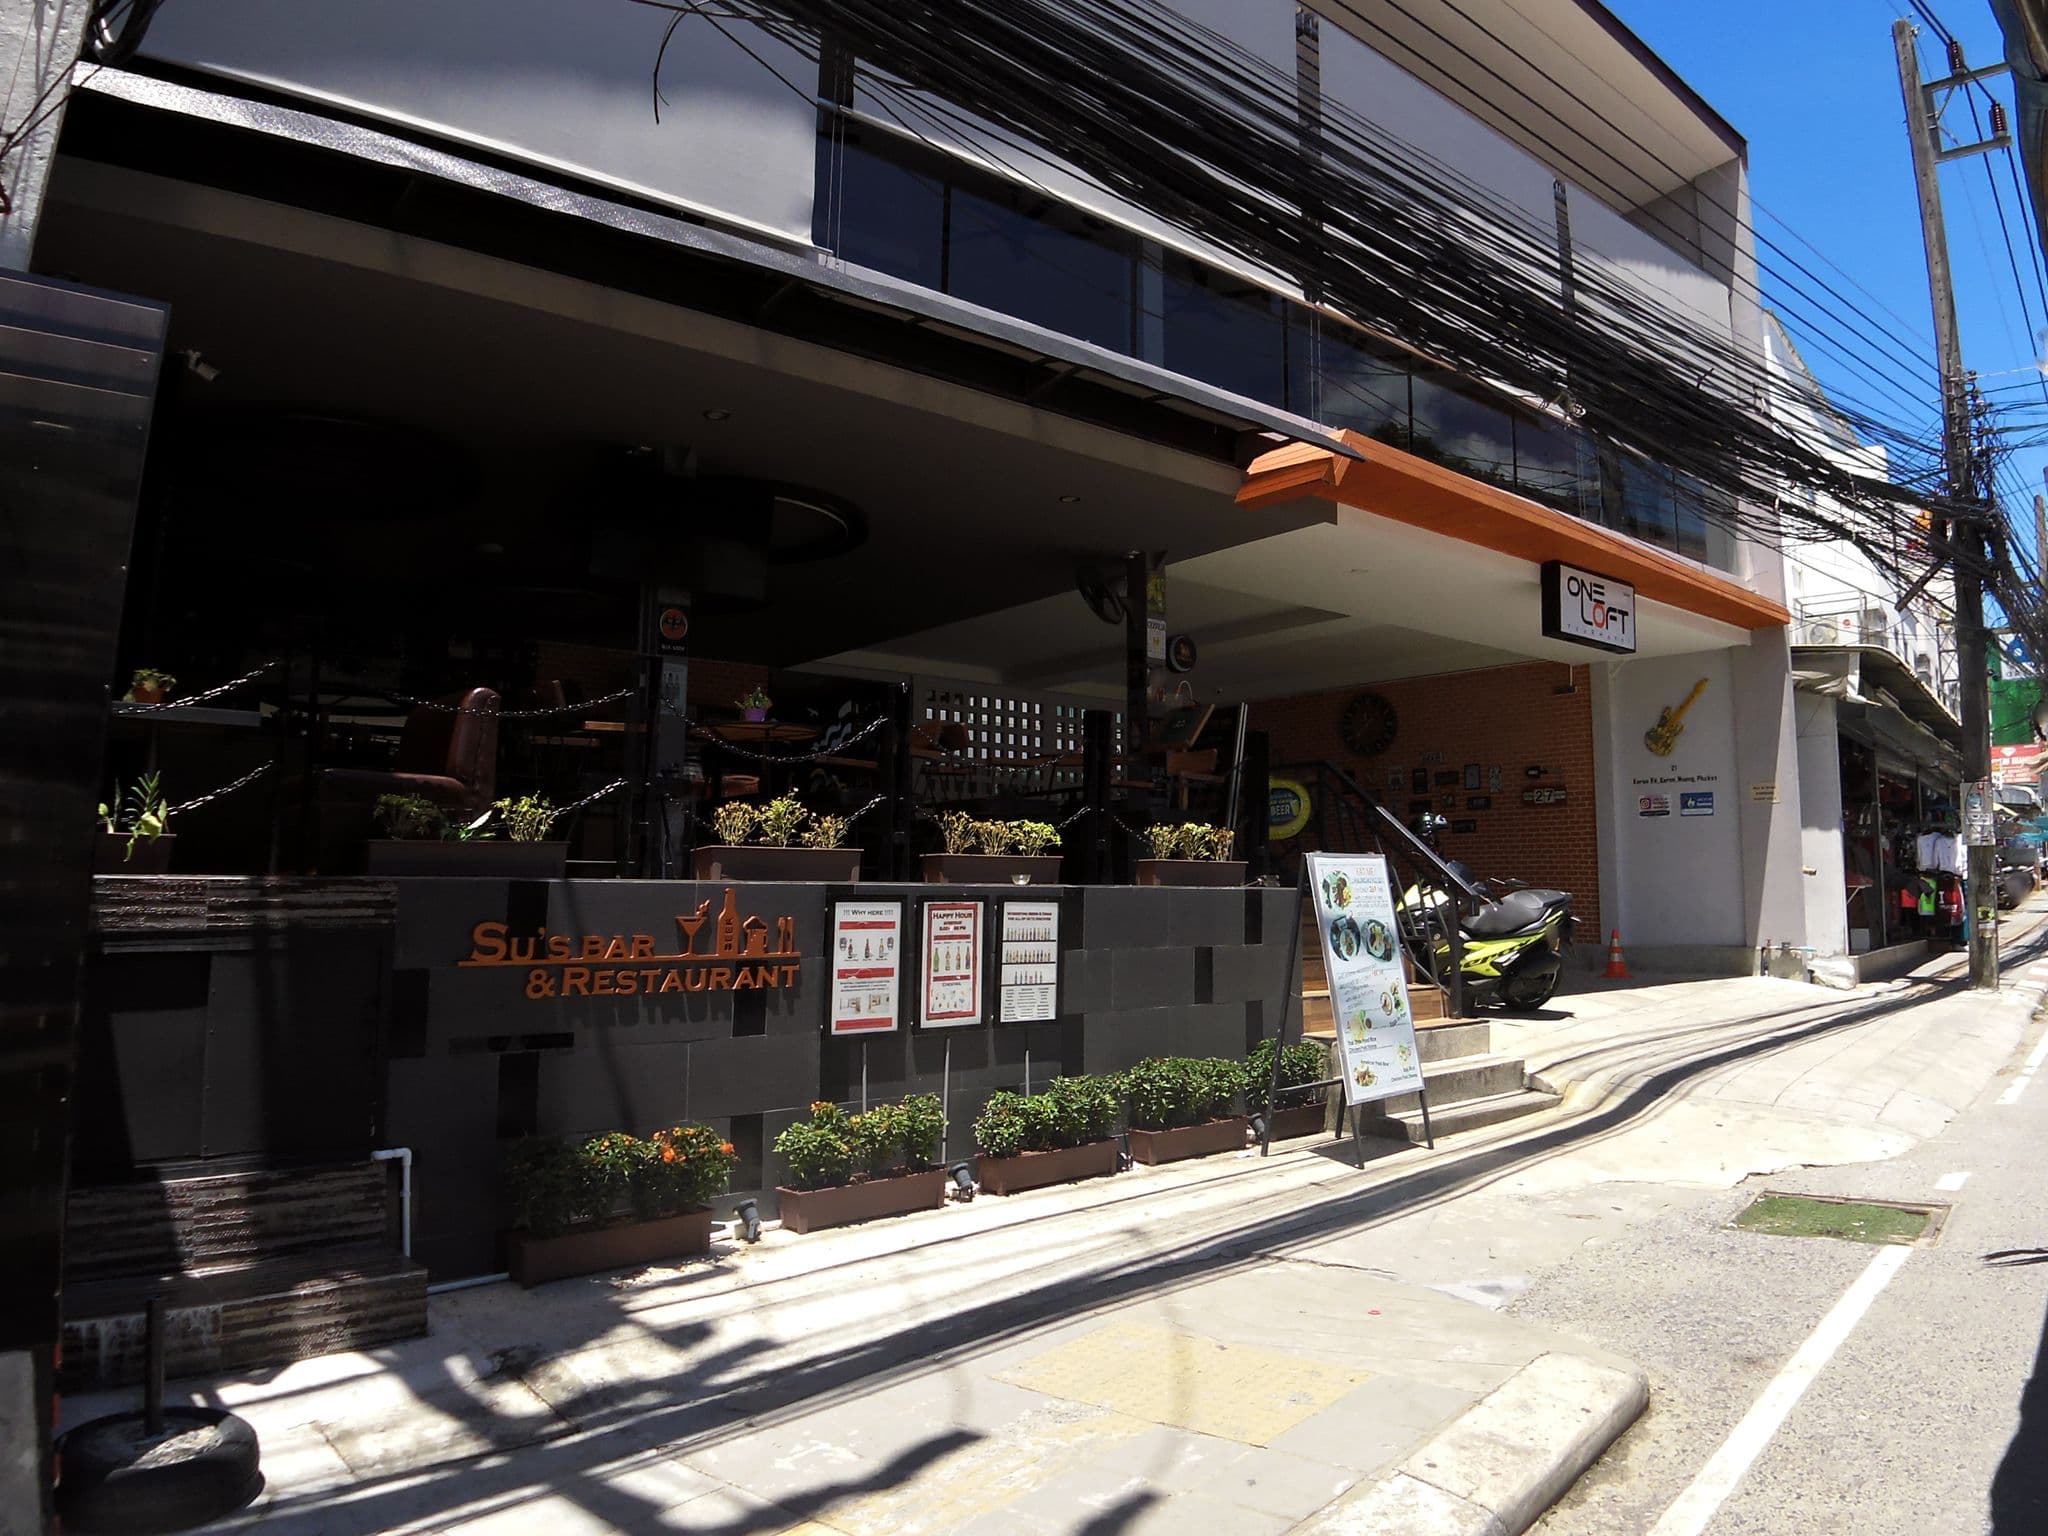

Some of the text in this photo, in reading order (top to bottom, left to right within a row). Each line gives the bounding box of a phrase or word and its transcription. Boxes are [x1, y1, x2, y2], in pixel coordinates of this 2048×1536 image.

[1567, 576, 1605, 605] ONE
[1581, 602, 1629, 634] LOFT
[1271, 805, 1290, 816] BEER
[582, 934, 656, 960] BAR
[526, 968, 556, 1000] &
